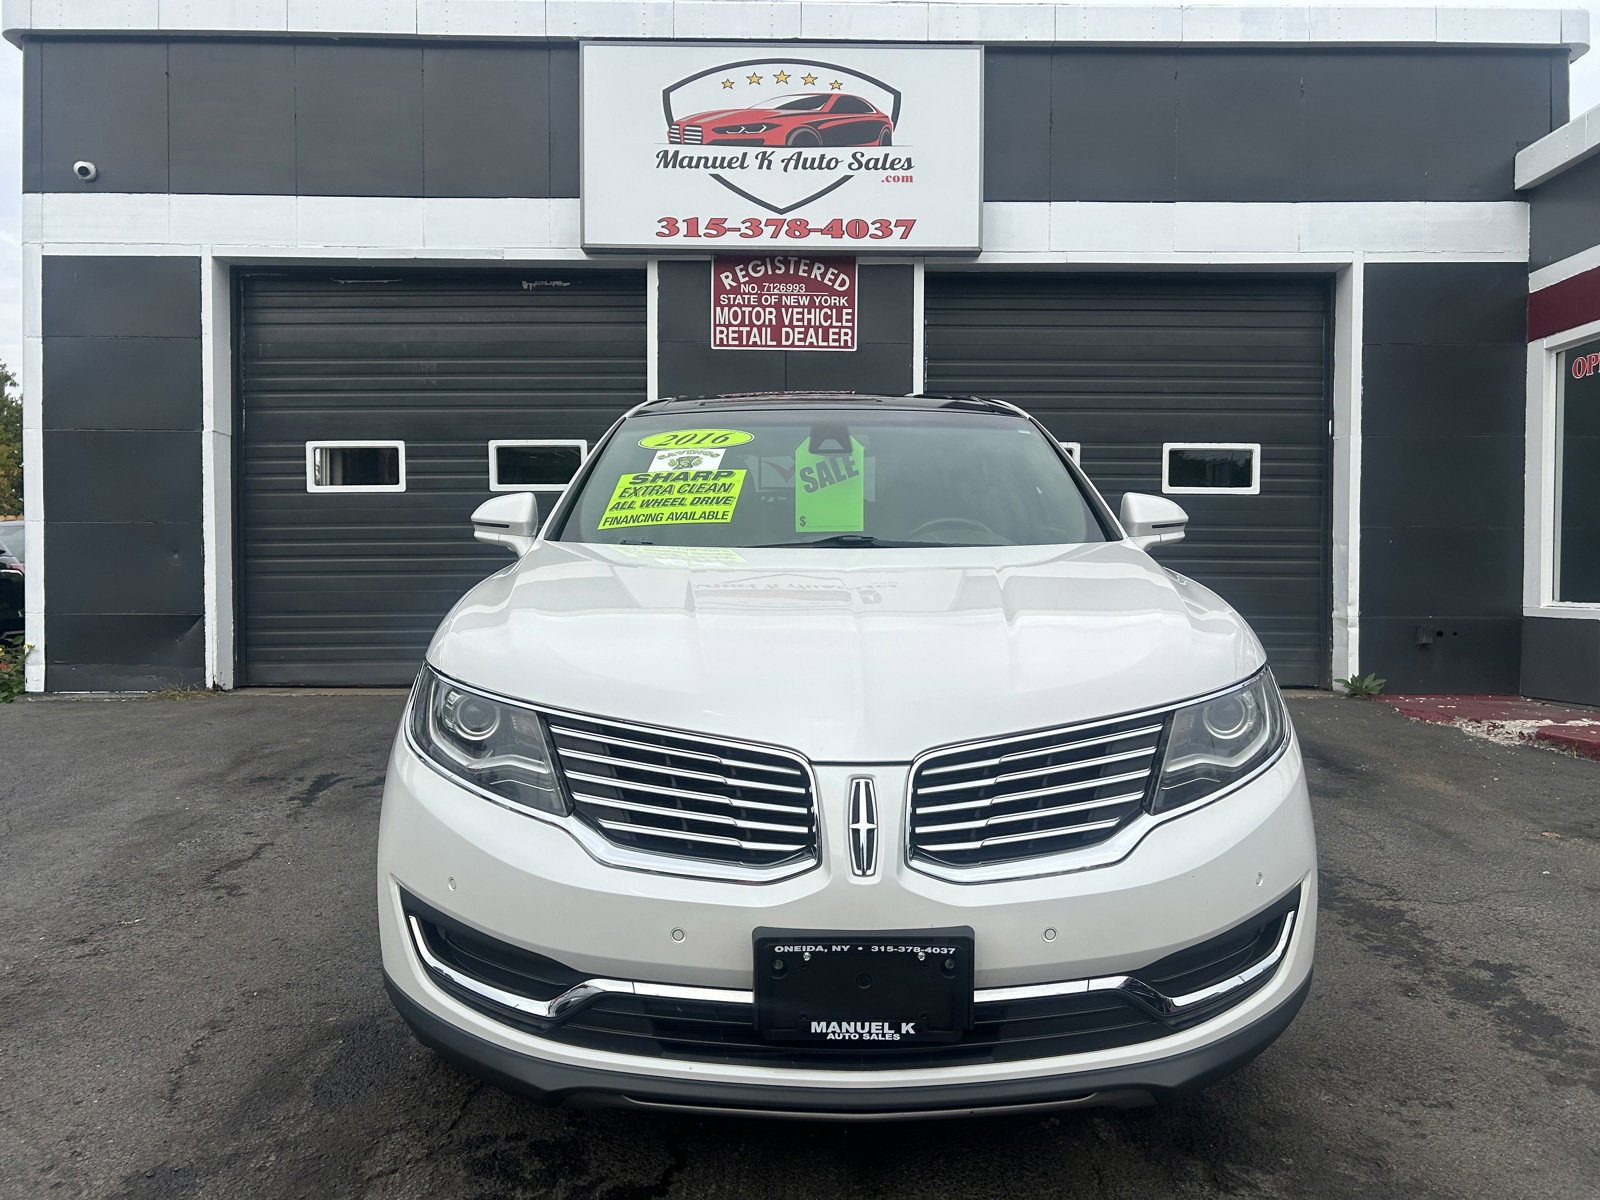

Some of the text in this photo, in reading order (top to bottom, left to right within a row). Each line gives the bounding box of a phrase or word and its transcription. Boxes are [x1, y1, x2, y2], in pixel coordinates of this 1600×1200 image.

[655, 150, 915, 172] Manuel K Auto Sales
[881, 173, 914, 183] .com
[655, 216, 917, 239] 315-378-4037
[719, 256, 850, 292] REGISTERED
[741, 283, 805, 293] NO. 7126993
[720, 295, 848, 306] STATE OF NEW YORK
[716, 307, 852, 326] MOTOR VEHICLE
[716, 327, 852, 346] RETAIL DEALER
[1572, 352, 1600, 379] OP
[655, 432, 735, 447] 2016
[629, 470, 736, 485] SHARP
[800, 456, 860, 493] SALE
[618, 482, 734, 499] EXTRA CLEAN
[609, 496, 736, 512] ALL WHEEL DRIVE
[603, 510, 729, 526] FINANCING AVAILABLE
[774, 945, 828, 953] ONEIDA,
[871, 945, 956, 954] 315-378-4037
[810, 1022, 916, 1034] MANUEL K
